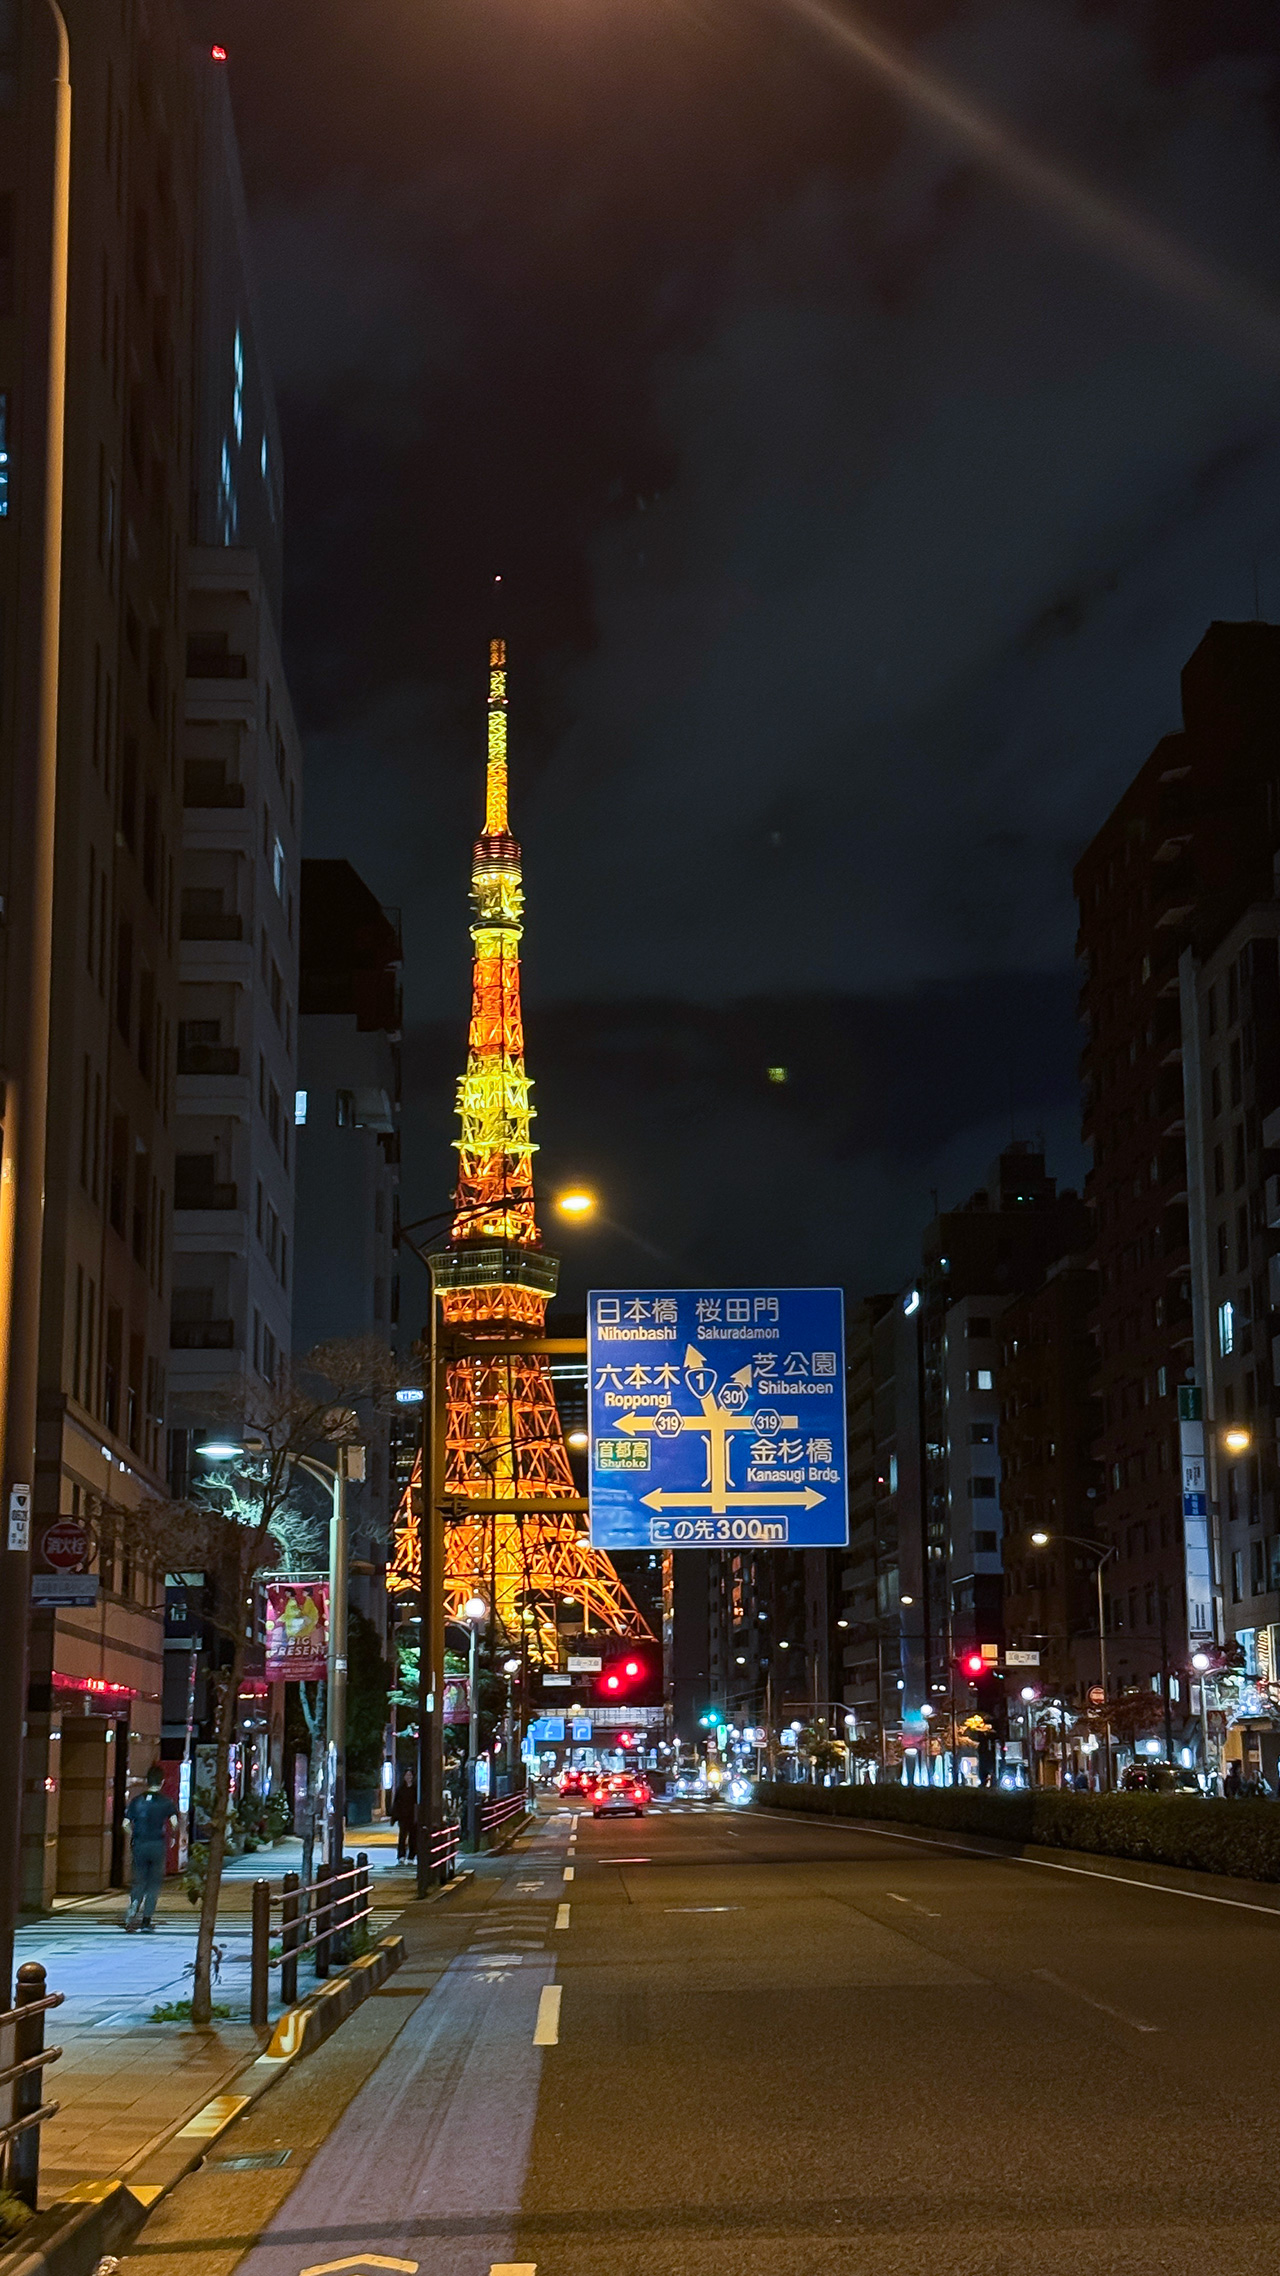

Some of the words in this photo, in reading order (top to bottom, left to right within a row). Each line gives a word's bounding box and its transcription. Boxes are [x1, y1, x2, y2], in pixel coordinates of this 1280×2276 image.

[597, 1298, 678, 1323] 日本橋
[695, 1298, 779, 1323] 桜田門
[597, 1326, 677, 1340] Nihonbashi
[697, 1326, 779, 1340] Sakuradamon
[752, 1352, 836, 1378] 芝公園
[595, 1362, 681, 1390] 六本木
[695, 1373, 704, 1390] 1
[758, 1380, 833, 1394] Shibakoen
[604, 1391, 672, 1410] Roppongi
[723, 1390, 744, 1404] 301
[657, 1416, 679, 1430] 319
[756, 1415, 778, 1430] 319
[598, 1442, 648, 1458] 首都高
[750, 1438, 833, 1464] 金杉橋
[600, 1459, 646, 1468] Shutoko
[747, 1467, 805, 1484] Kanasugi
[809, 1467, 841, 1483] Brdg.
[653, 1520, 784, 1540] この先300m
[46, 1537, 86, 1554] 消火栓
[288, 1637, 310, 1645] BIG
[271, 1646, 325, 1656] PRESENT
